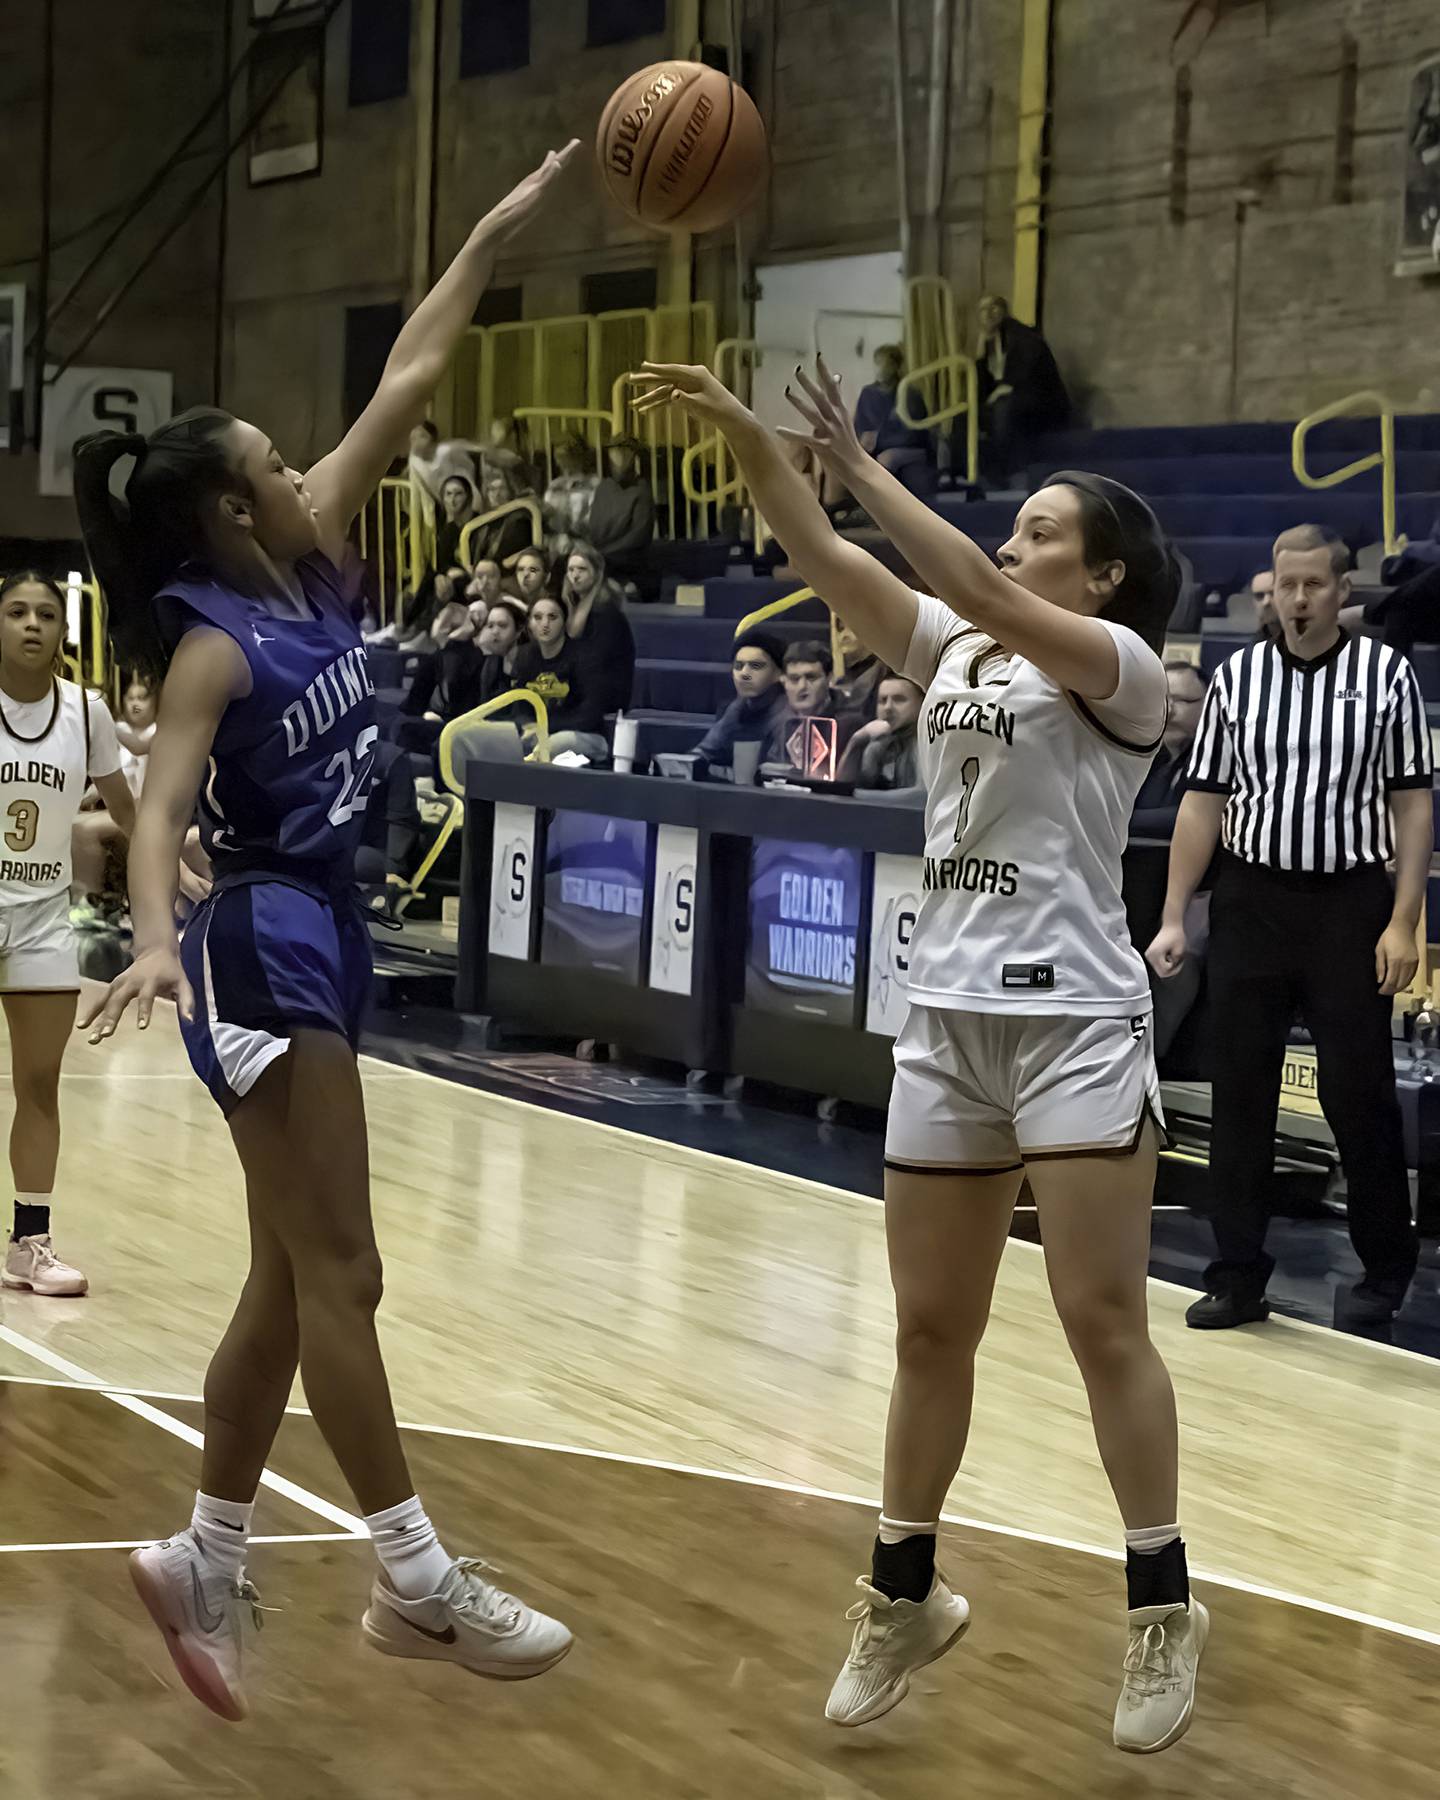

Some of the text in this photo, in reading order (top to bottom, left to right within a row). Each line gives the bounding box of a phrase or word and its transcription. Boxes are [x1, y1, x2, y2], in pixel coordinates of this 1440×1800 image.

[92, 386, 139, 434] S
[282, 646, 376, 758] QUINC
[927, 699, 1015, 746] GOLDEN
[0, 761, 66, 792] OLDEN
[324, 724, 379, 827] 22
[953, 756, 980, 844] 1
[4, 798, 40, 852] 3
[511, 852, 527, 902] S
[779, 871, 845, 927] GOLDEN
[674, 879, 693, 933] S
[769, 923, 856, 986] WARRIORS
[1037, 970, 1047, 982] M
